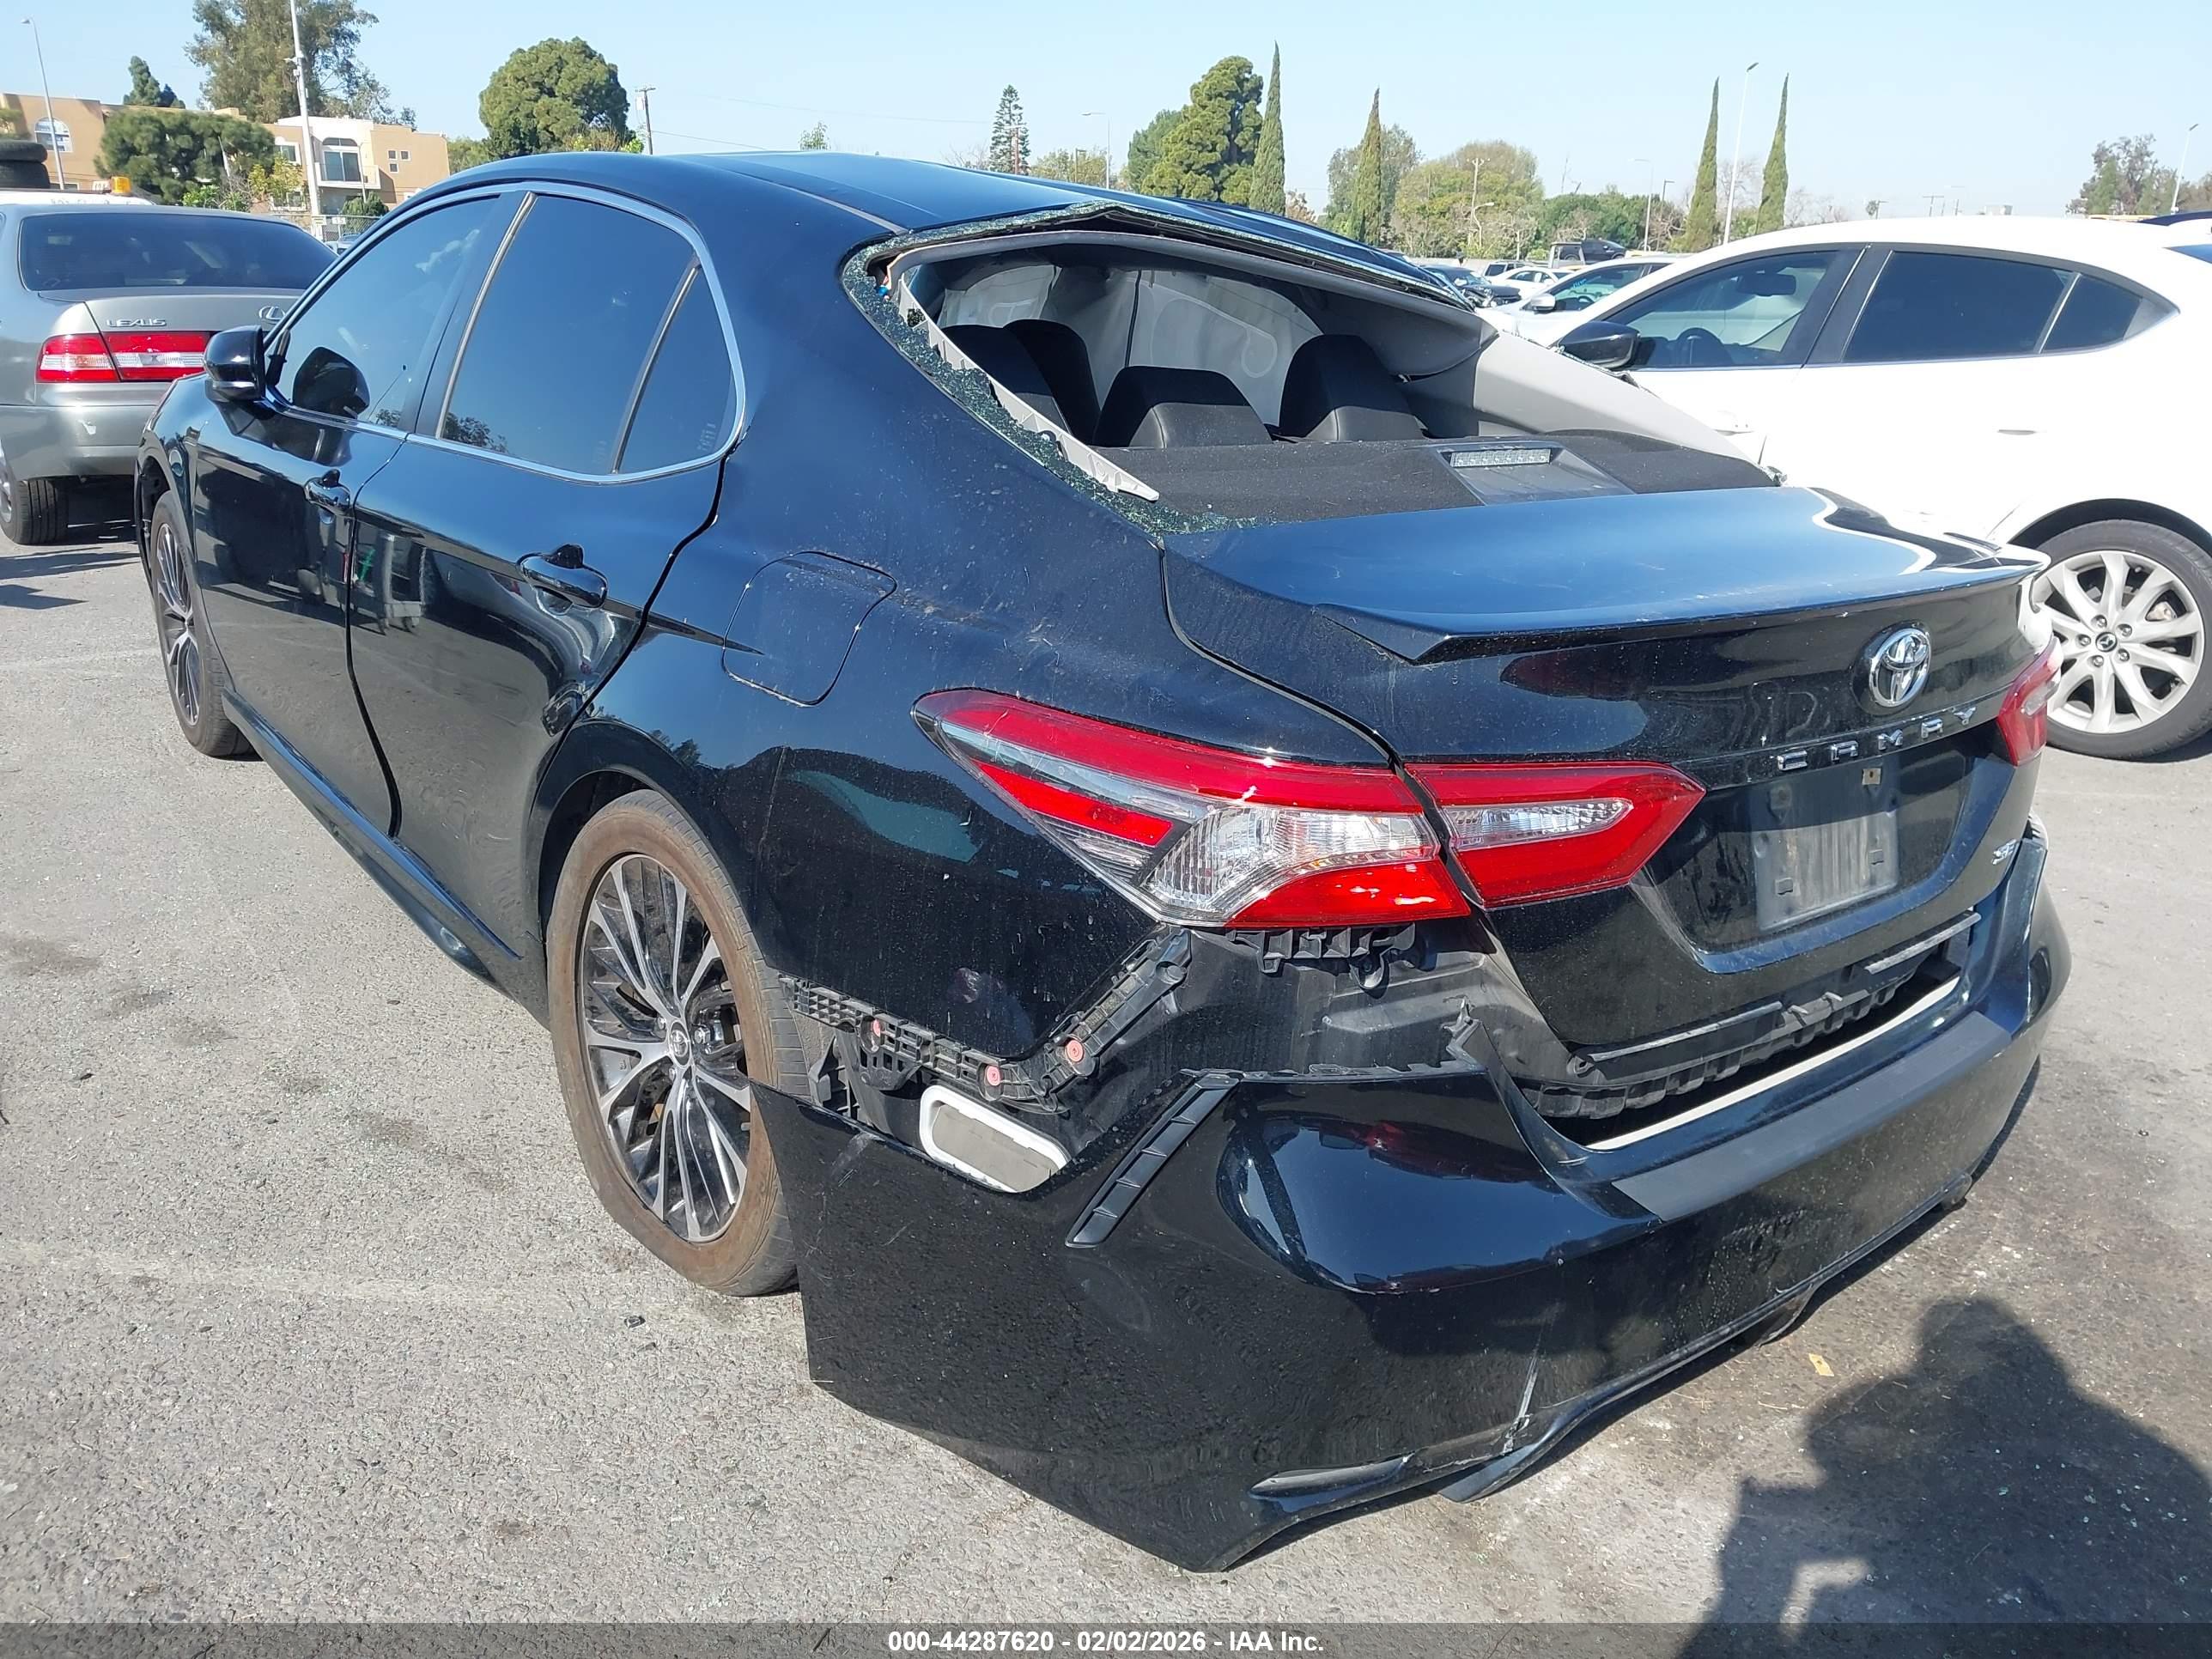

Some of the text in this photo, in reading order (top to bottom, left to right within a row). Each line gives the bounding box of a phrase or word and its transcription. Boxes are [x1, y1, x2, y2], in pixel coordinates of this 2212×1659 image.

[106, 318, 167, 327] LEXUS
[1777, 707, 1976, 771] CAMRY
[1990, 839, 2017, 865] SE
